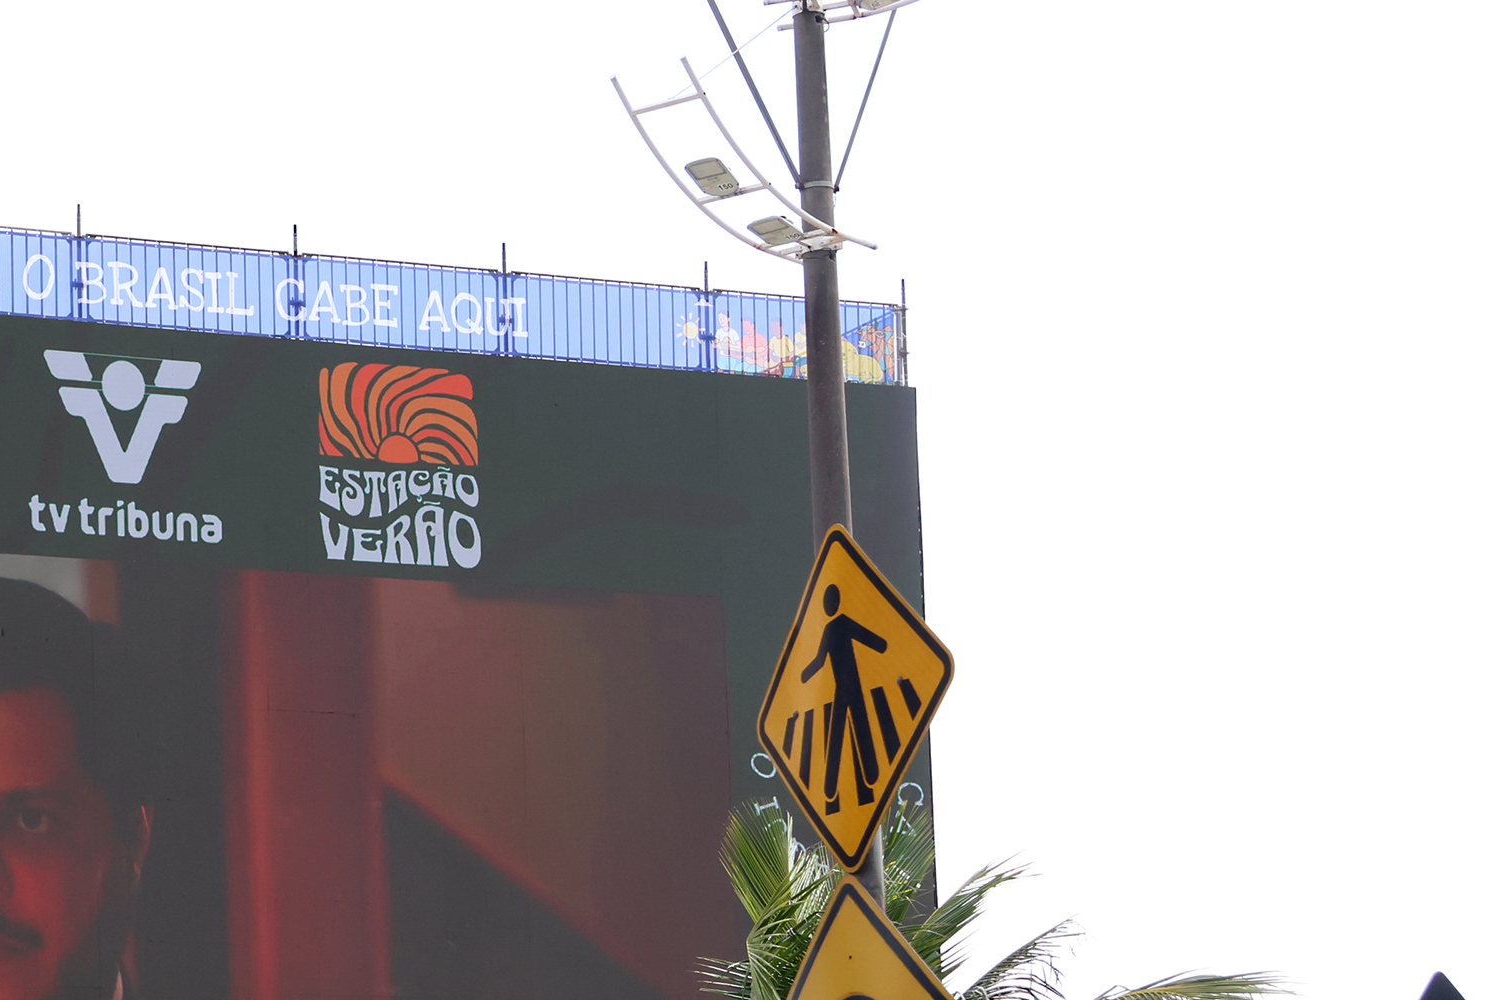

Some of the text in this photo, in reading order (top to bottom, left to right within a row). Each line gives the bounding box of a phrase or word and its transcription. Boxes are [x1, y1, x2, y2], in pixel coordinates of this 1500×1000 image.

[718, 183, 734, 191] 150
[22, 254, 55, 300] O
[75, 260, 254, 317] BRASIL
[276, 279, 399, 328] CABE
[418, 291, 529, 338] AQUI
[318, 464, 480, 517] ESTAÇÃO
[28, 493, 223, 544] tv tribuna
[318, 501, 483, 569] VERÃO
